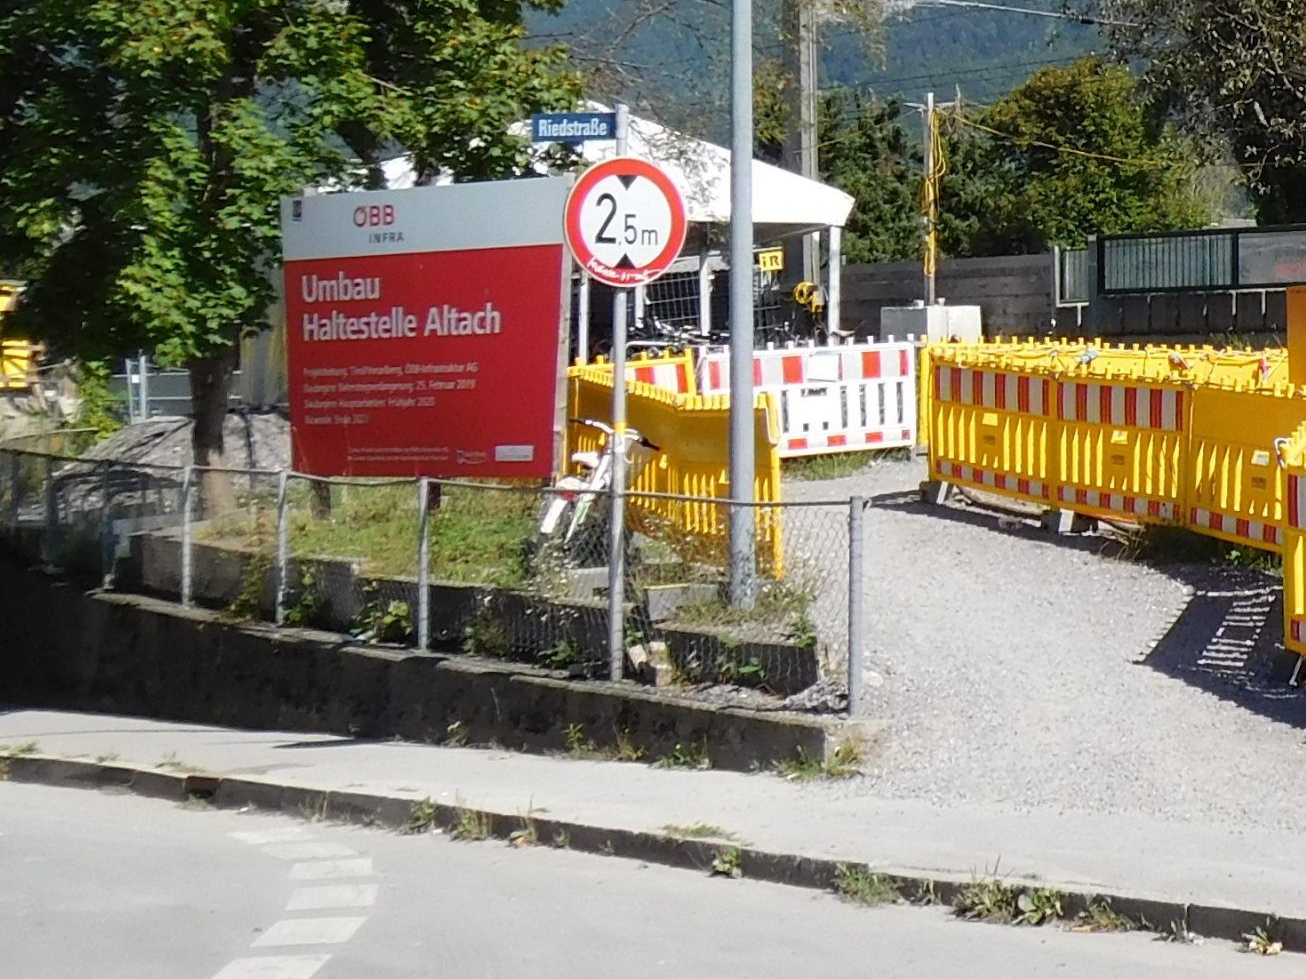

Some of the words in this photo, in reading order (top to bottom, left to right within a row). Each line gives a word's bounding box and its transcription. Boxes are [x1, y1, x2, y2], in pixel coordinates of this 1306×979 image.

[538, 118, 608, 137] Riedstraße
[353, 204, 395, 227] ÖBB
[368, 232, 404, 244] INFRA
[302, 271, 380, 303] Umbau
[303, 307, 417, 341] Haltestelle
[423, 302, 501, 337] Altach
